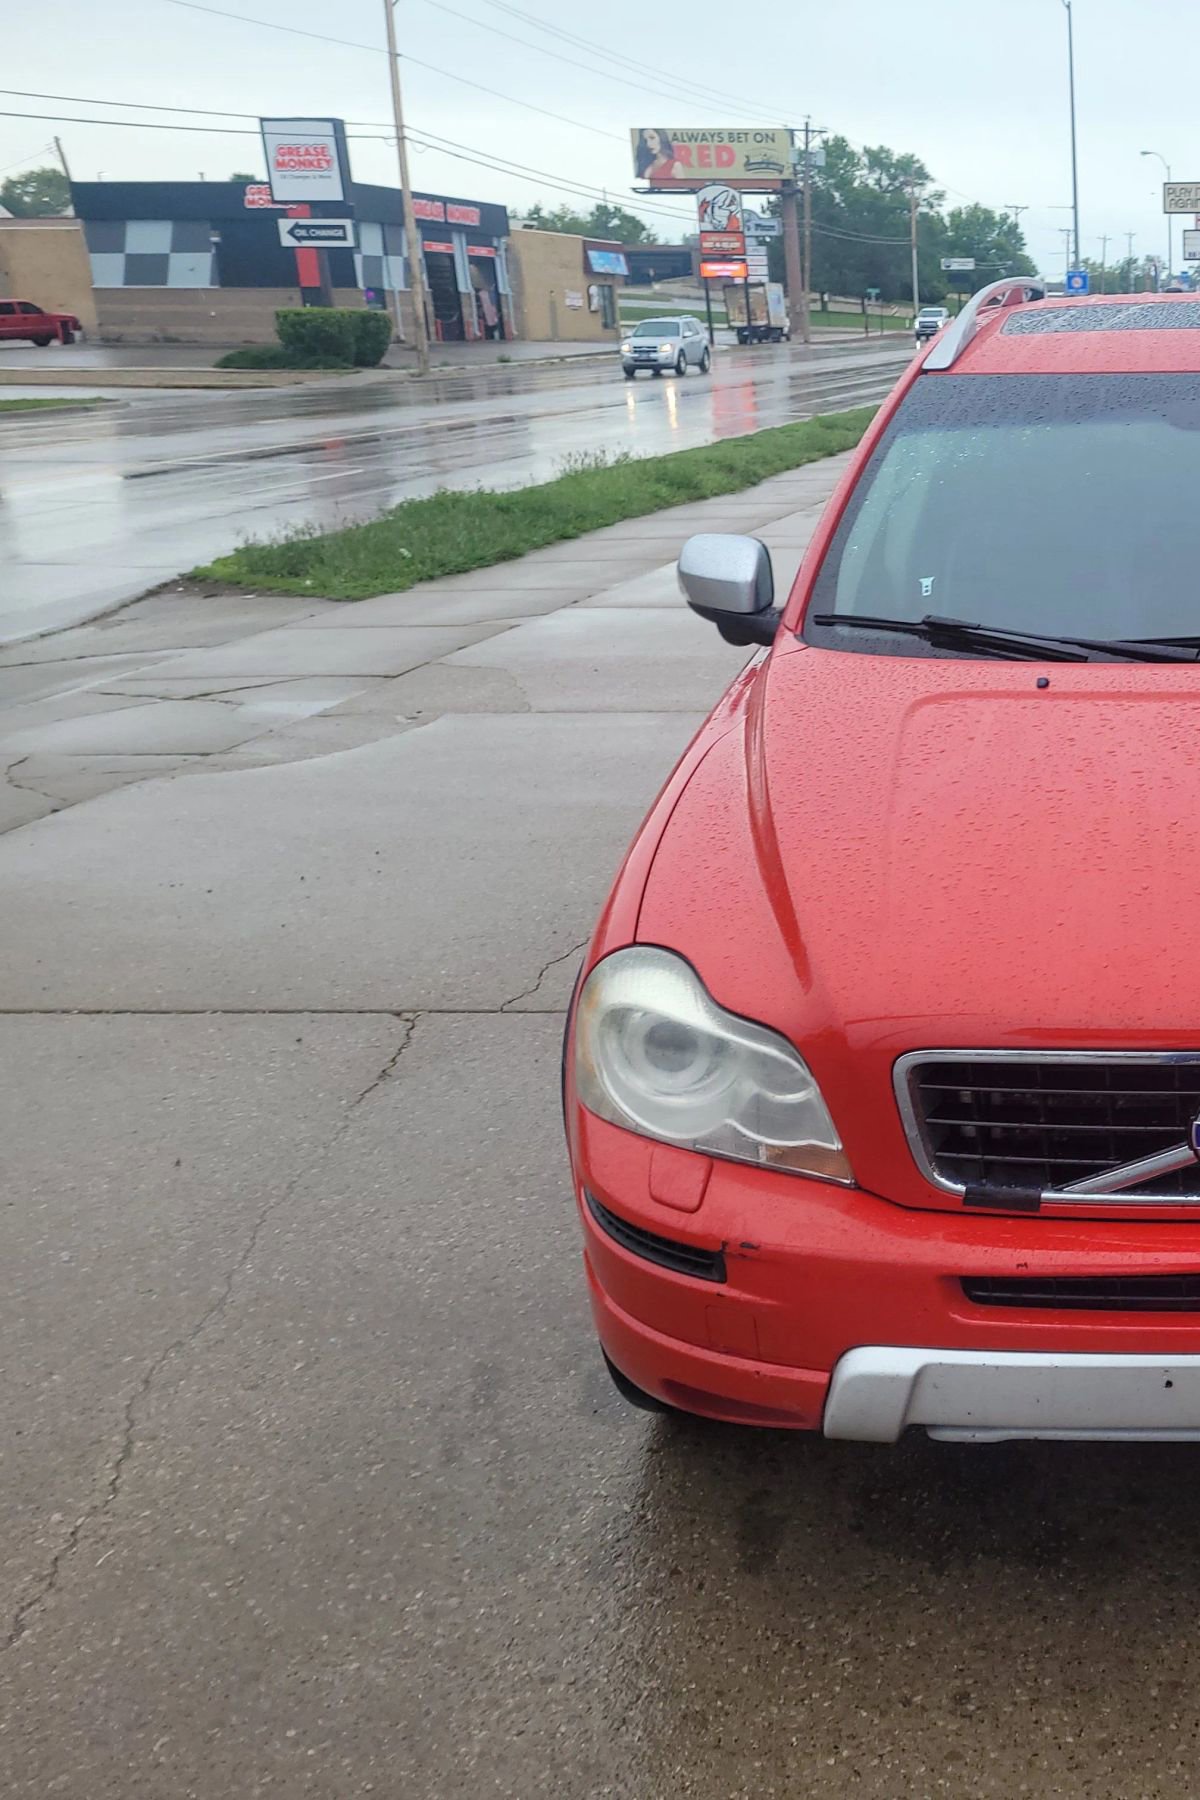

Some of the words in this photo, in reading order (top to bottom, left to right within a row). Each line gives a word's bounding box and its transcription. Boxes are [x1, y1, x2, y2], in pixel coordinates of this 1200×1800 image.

[671, 132, 724, 143] ALWAYS
[728, 132, 750, 143] BET
[753, 132, 776, 143] ON
[275, 144, 329, 157] GREASE
[673, 144, 736, 168] RED
[274, 157, 333, 170] MONKEY
[1167, 187, 1193, 197] PLAY
[293, 228, 307, 236] OIL
[309, 228, 344, 237] CHANGE
